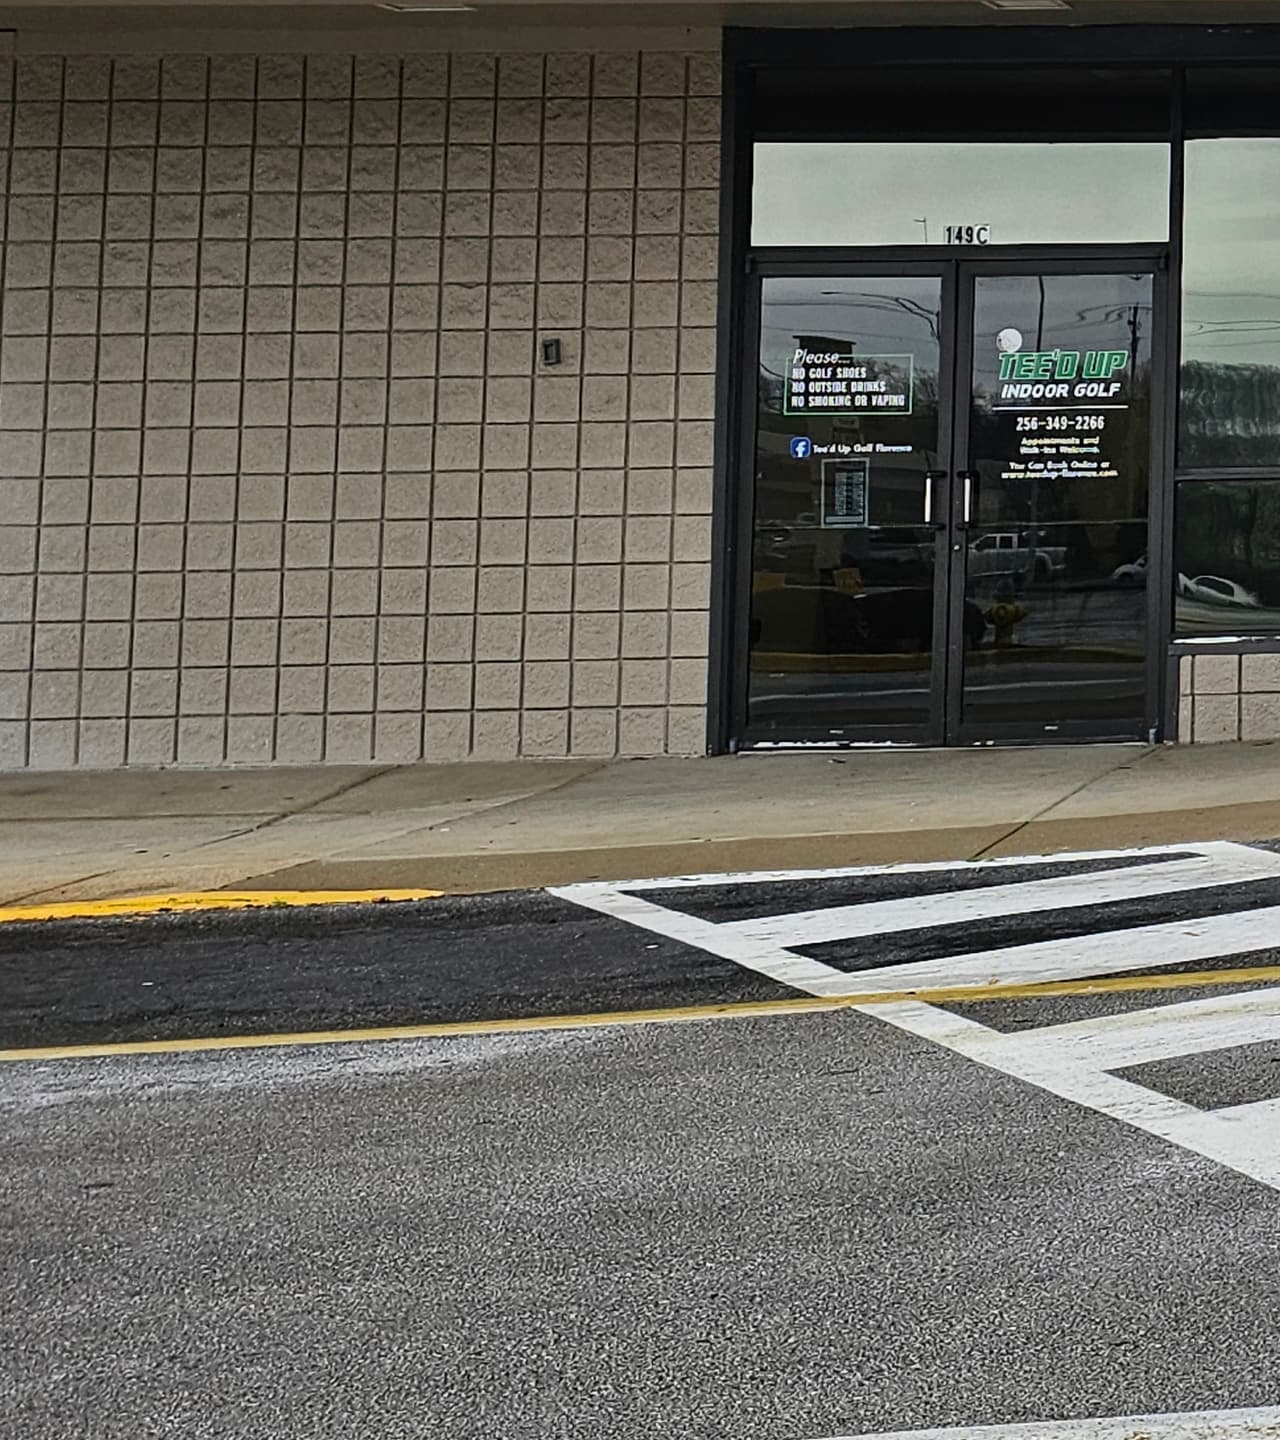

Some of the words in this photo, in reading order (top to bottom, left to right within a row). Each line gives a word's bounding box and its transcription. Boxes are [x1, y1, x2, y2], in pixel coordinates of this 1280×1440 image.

[945, 225, 989, 245] 149C
[999, 349, 1080, 380] TEE'D
[1082, 350, 1128, 380] UP
[792, 367, 806, 380] NO
[808, 367, 833, 379] GOLF
[836, 367, 867, 379] SHOES
[791, 381, 805, 393] NO
[808, 381, 847, 393] OUTSIDE
[851, 381, 886, 393] DRINKS
[1001, 383, 1069, 399] INDOOR
[1074, 383, 1121, 398] GOLF
[791, 395, 805, 407] NO
[808, 395, 852, 407] SMOKING
[854, 395, 868, 407] OR
[871, 394, 905, 407] VAPING
[1016, 415, 1105, 431] 256-349-2266
[837, 444, 851, 455] Up
[853, 443, 874, 452] Golf
